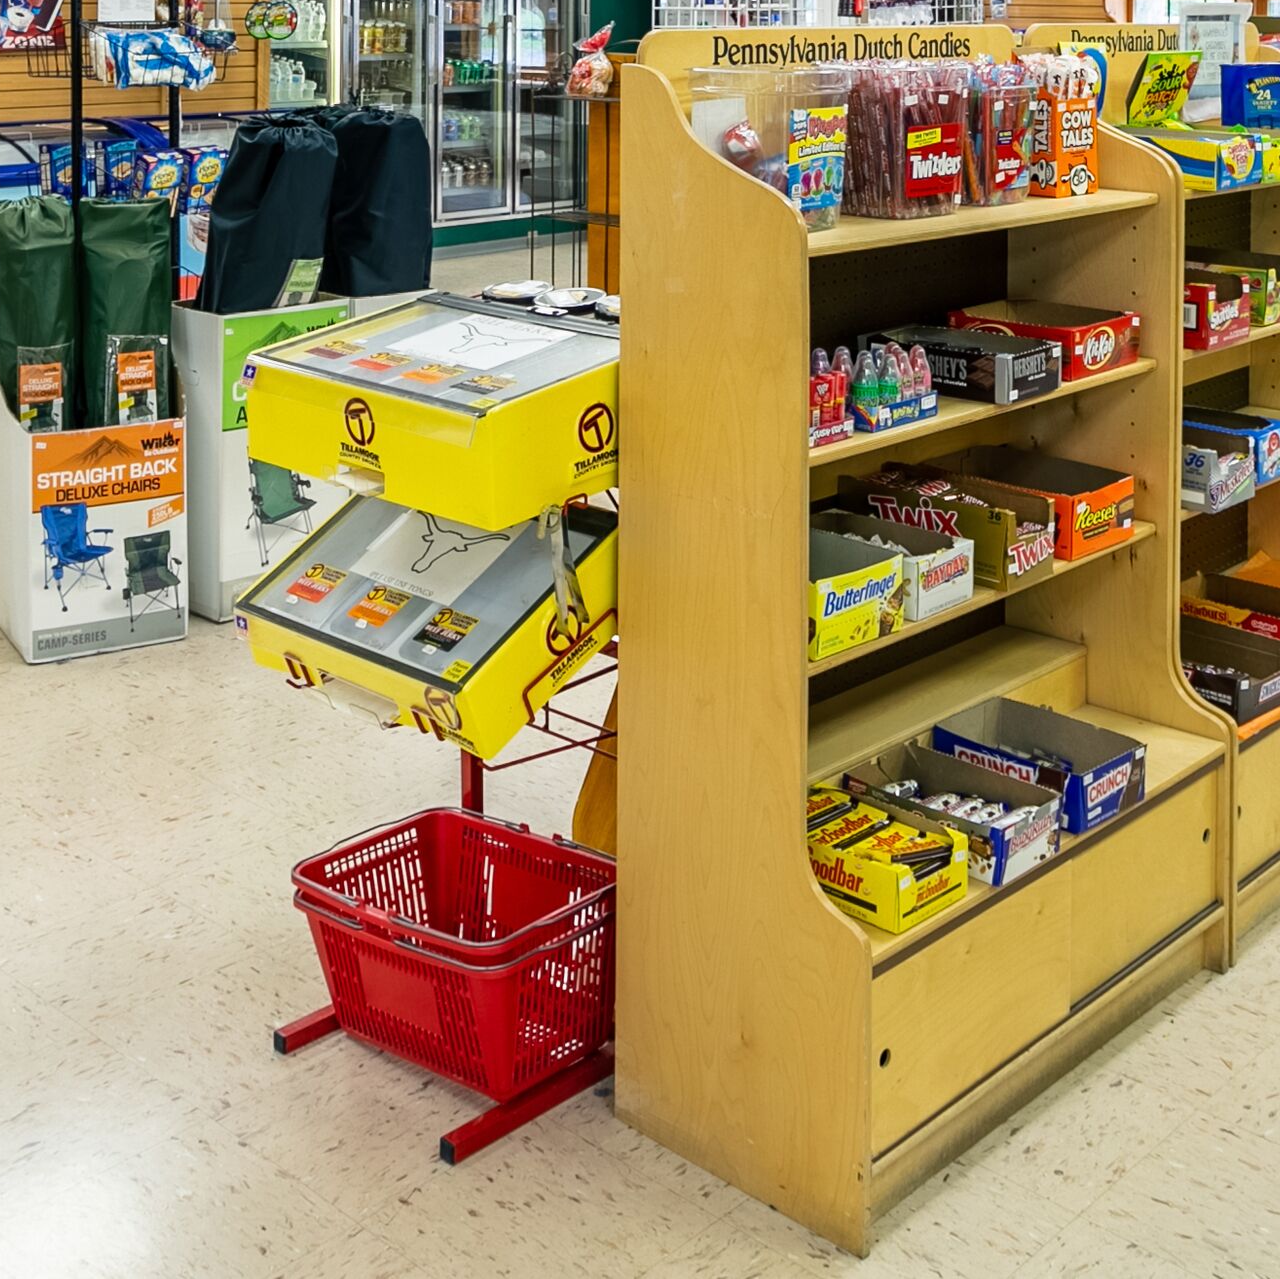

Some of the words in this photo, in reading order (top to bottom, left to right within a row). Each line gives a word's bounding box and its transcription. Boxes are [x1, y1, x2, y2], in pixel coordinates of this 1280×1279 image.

[2, 35, 55, 49] ZONE
[712, 34, 848, 66] Pennsylvania
[853, 32, 903, 61] Dutch
[908, 31, 970, 58] Candies
[1150, 76, 1183, 93] SOUR
[1257, 89, 1271, 101] 24
[1144, 89, 1179, 104] PATCH
[1034, 99, 1049, 153] TALES
[1062, 110, 1092, 130] COW
[1061, 127, 1094, 149] TALES
[798, 142, 821, 158] Limited
[1013, 352, 1046, 379] HERSHEY'S
[22, 383, 58, 392] STRAIGHT
[141, 434, 180, 451] Wilcor
[341, 441, 380, 462] TILLAMOOK
[1184, 452, 1205, 468] 36
[37, 465, 127, 489] STRAIGHT
[130, 457, 177, 478] BACK
[56, 484, 109, 502] DELUXE
[111, 477, 161, 496] CHAIRS
[987, 510, 1002, 521] 36
[1008, 533, 1055, 575] TWIX
[924, 554, 968, 590] PAYDAY
[313, 582, 331, 593] JERKY
[823, 571, 897, 617] Butterfinger
[1182, 601, 1228, 622] Starburst
[37, 629, 108, 651] CAMP-SERIES
[441, 628, 463, 642] JERKY
[549, 633, 596, 681] TILLAMOOK
[1088, 765, 1129, 803] CRUNCH
